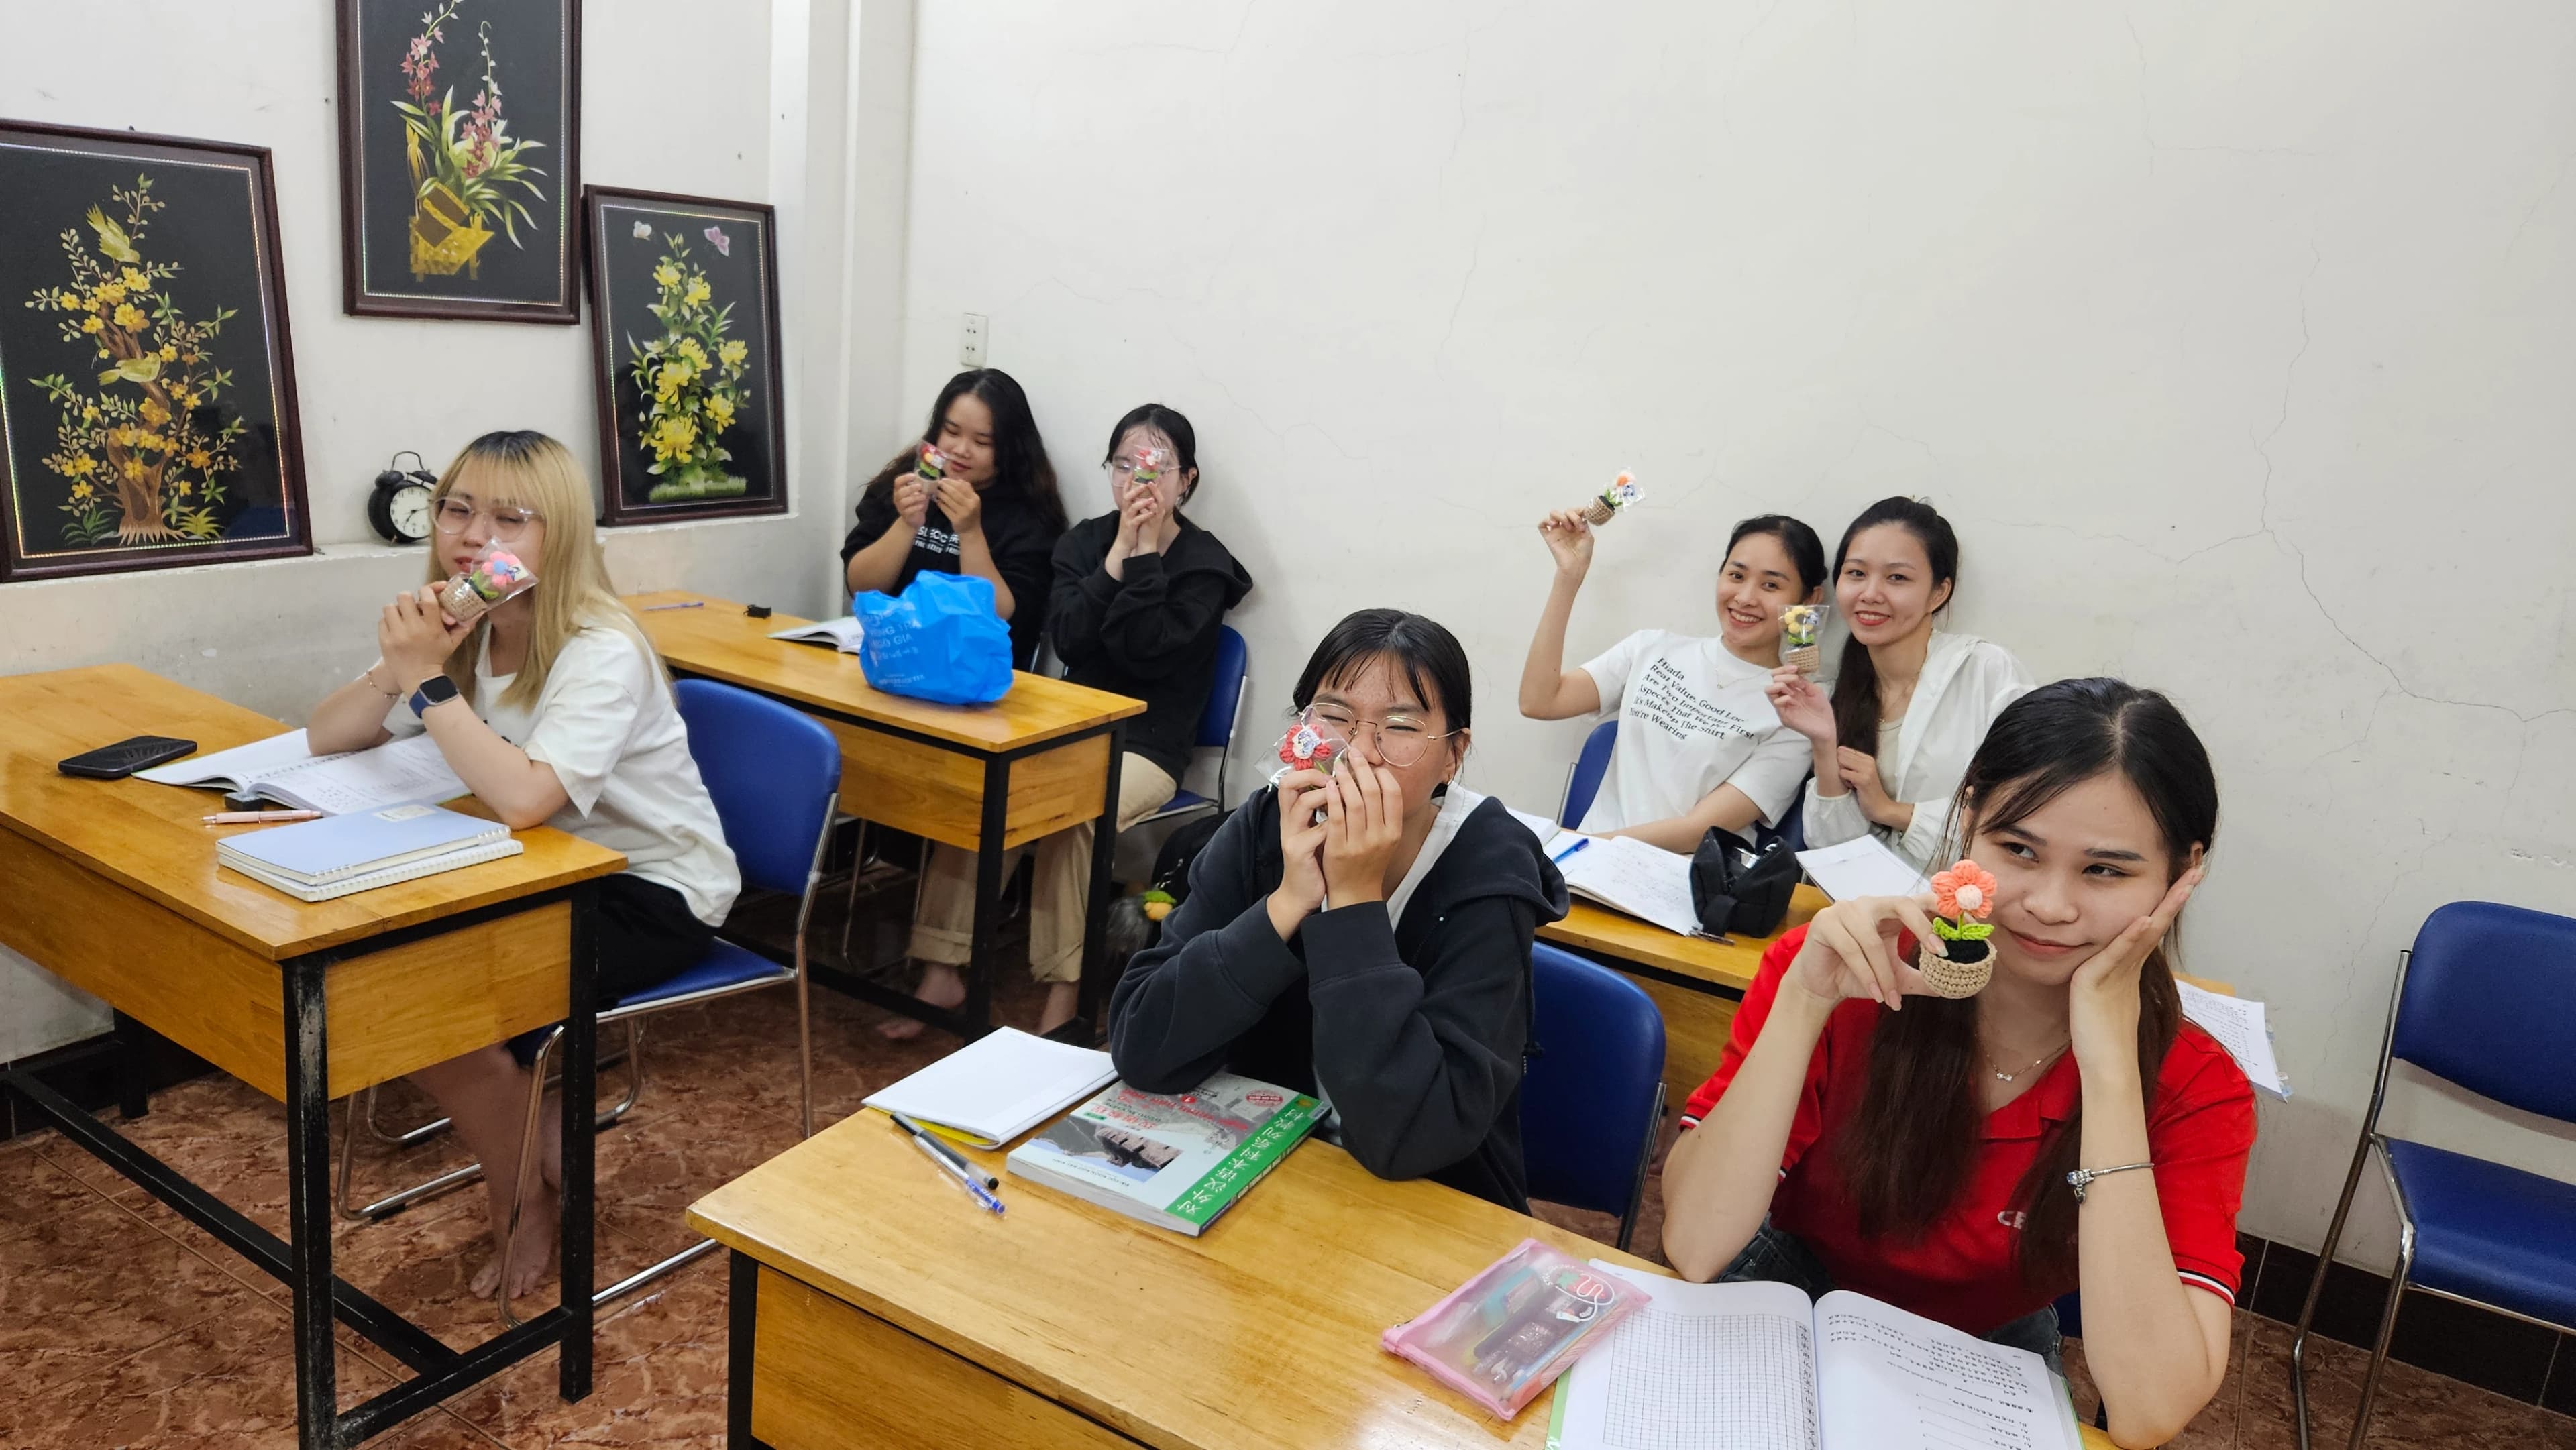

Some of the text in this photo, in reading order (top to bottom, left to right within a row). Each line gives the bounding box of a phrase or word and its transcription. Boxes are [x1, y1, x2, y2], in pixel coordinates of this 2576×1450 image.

[1642, 673, 1660, 686] Are
[1661, 685, 1678, 702] Two
[1639, 684, 1670, 706] Aspects
[1671, 705, 1693, 718] That
[1729, 724, 1754, 740] First
[1644, 698, 1679, 724] Makeup
[1680, 720, 1697, 730] The
[1697, 726, 1726, 740] Shirt
[1699, 700, 1725, 716] Good
[1651, 714, 1688, 740] Wearing
[1176, 1107, 1306, 1217] 对外汉语本科系列教材
